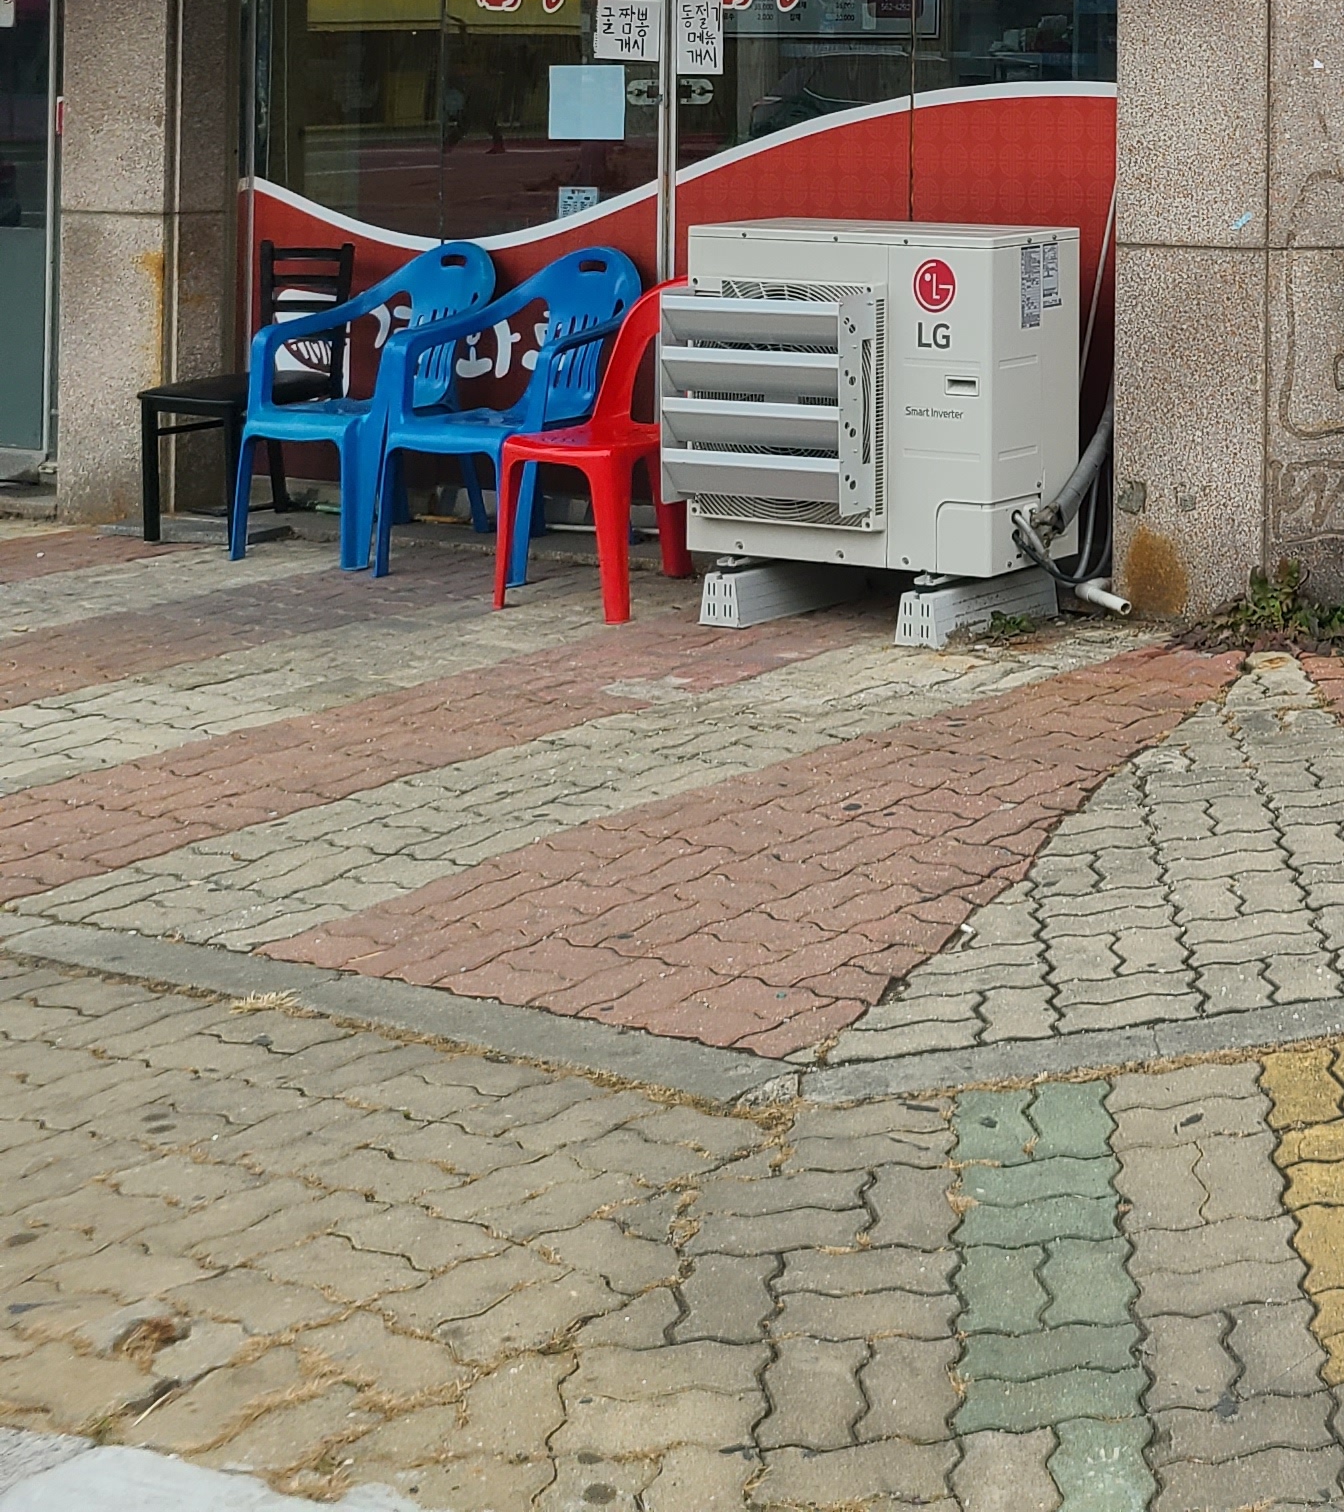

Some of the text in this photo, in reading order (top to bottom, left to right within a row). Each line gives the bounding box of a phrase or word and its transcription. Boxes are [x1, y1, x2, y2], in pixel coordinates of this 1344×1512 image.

[681, 1, 722, 32] 동절기
[615, 38, 645, 57] 개시
[686, 49, 718, 69] 개시
[917, 322, 951, 350] LG
[905, 407, 964, 421] Smart Inverter
